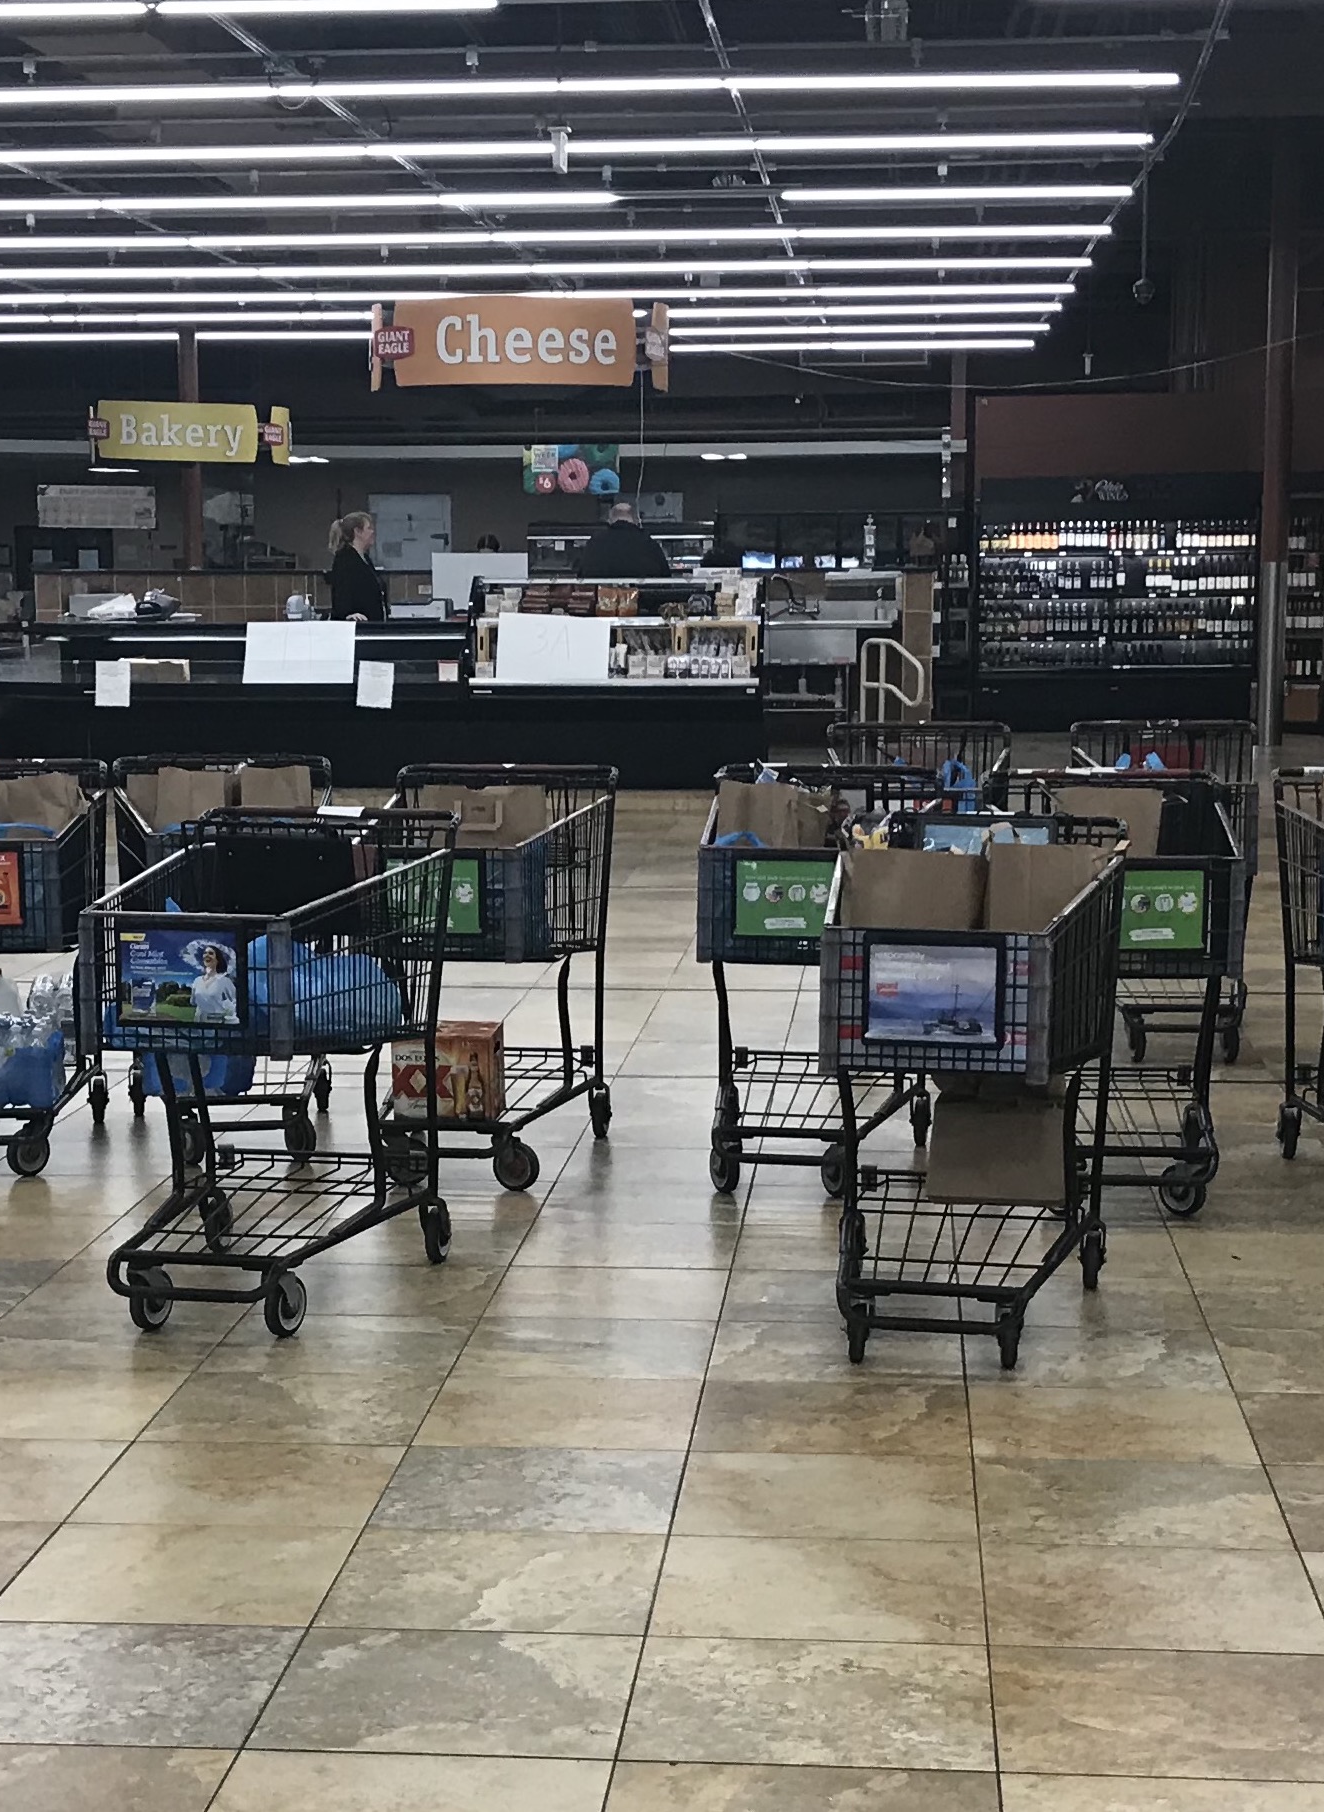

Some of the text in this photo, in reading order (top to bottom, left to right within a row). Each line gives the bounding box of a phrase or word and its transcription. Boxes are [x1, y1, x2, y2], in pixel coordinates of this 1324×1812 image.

[377, 330, 410, 342] GIANT
[436, 313, 617, 365] Cheese
[378, 341, 410, 354] EAGLE
[119, 413, 243, 456] Bakery
[394, 1054, 413, 1062] DOS
